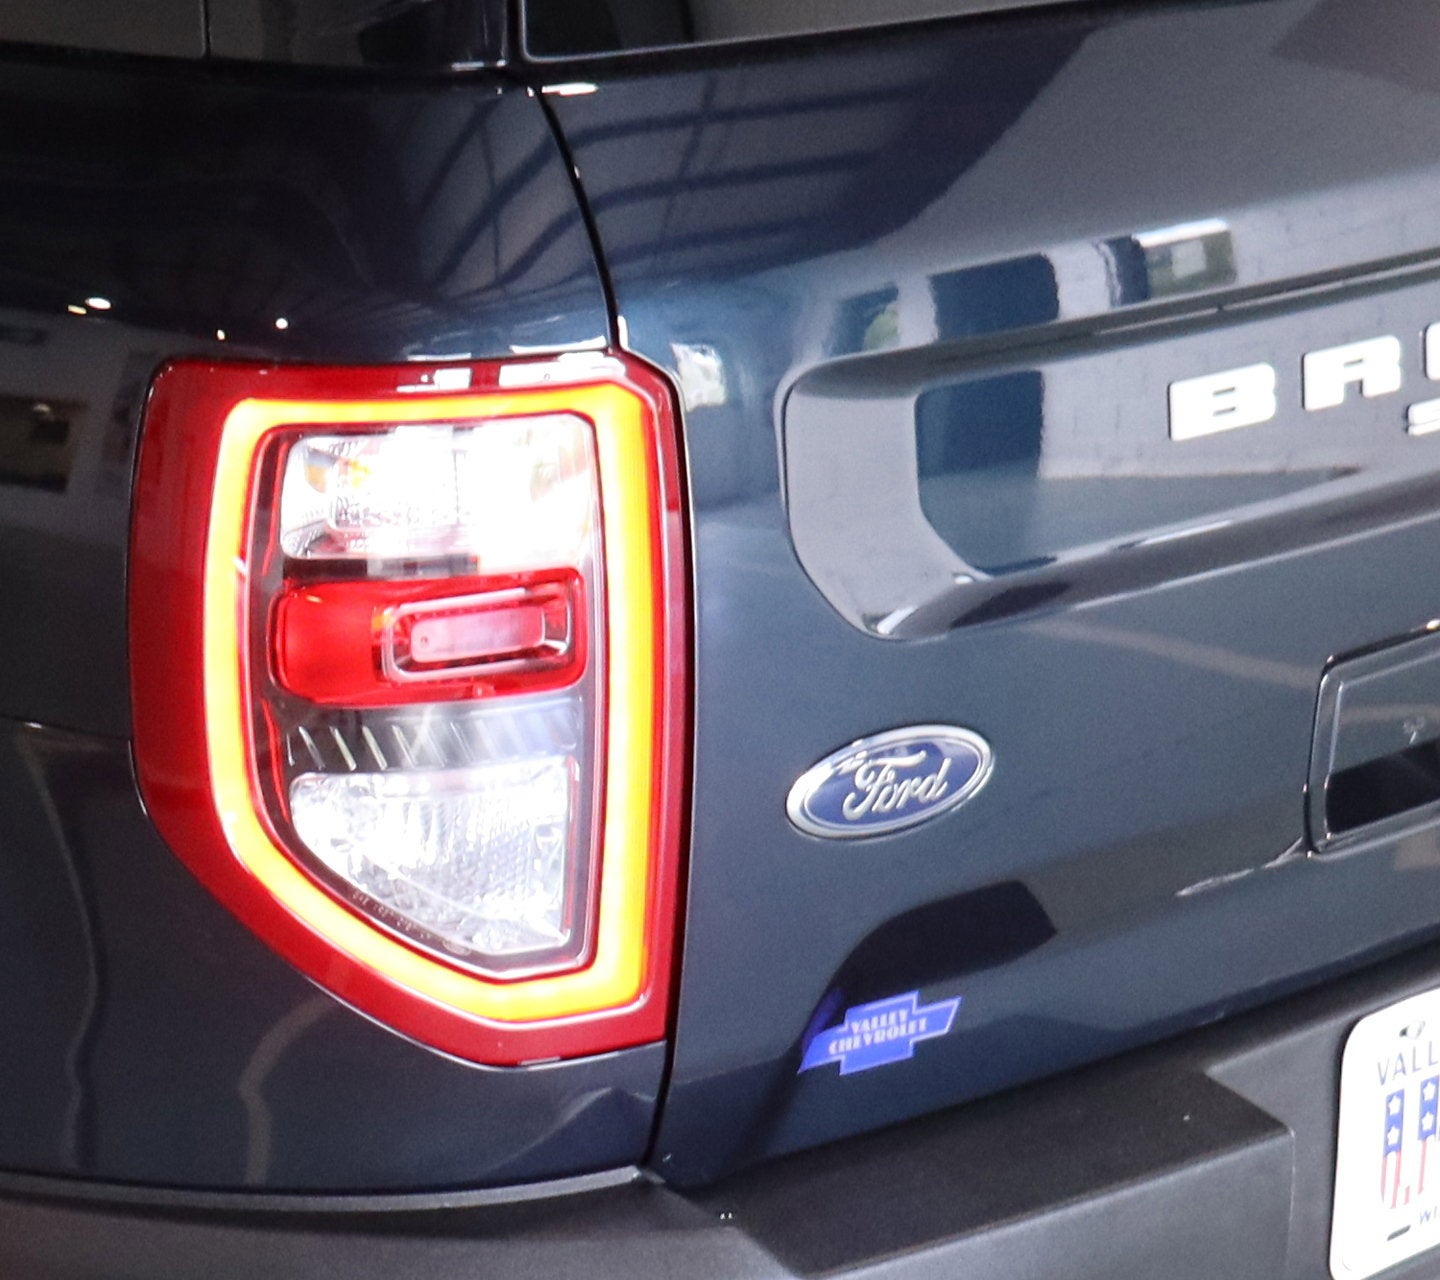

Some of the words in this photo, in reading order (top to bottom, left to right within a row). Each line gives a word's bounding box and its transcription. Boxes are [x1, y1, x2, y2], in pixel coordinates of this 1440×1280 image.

[842, 750, 952, 821] Ford
[828, 1017, 928, 1056] CHEVROLET
[850, 1009, 909, 1035] VALLEY
